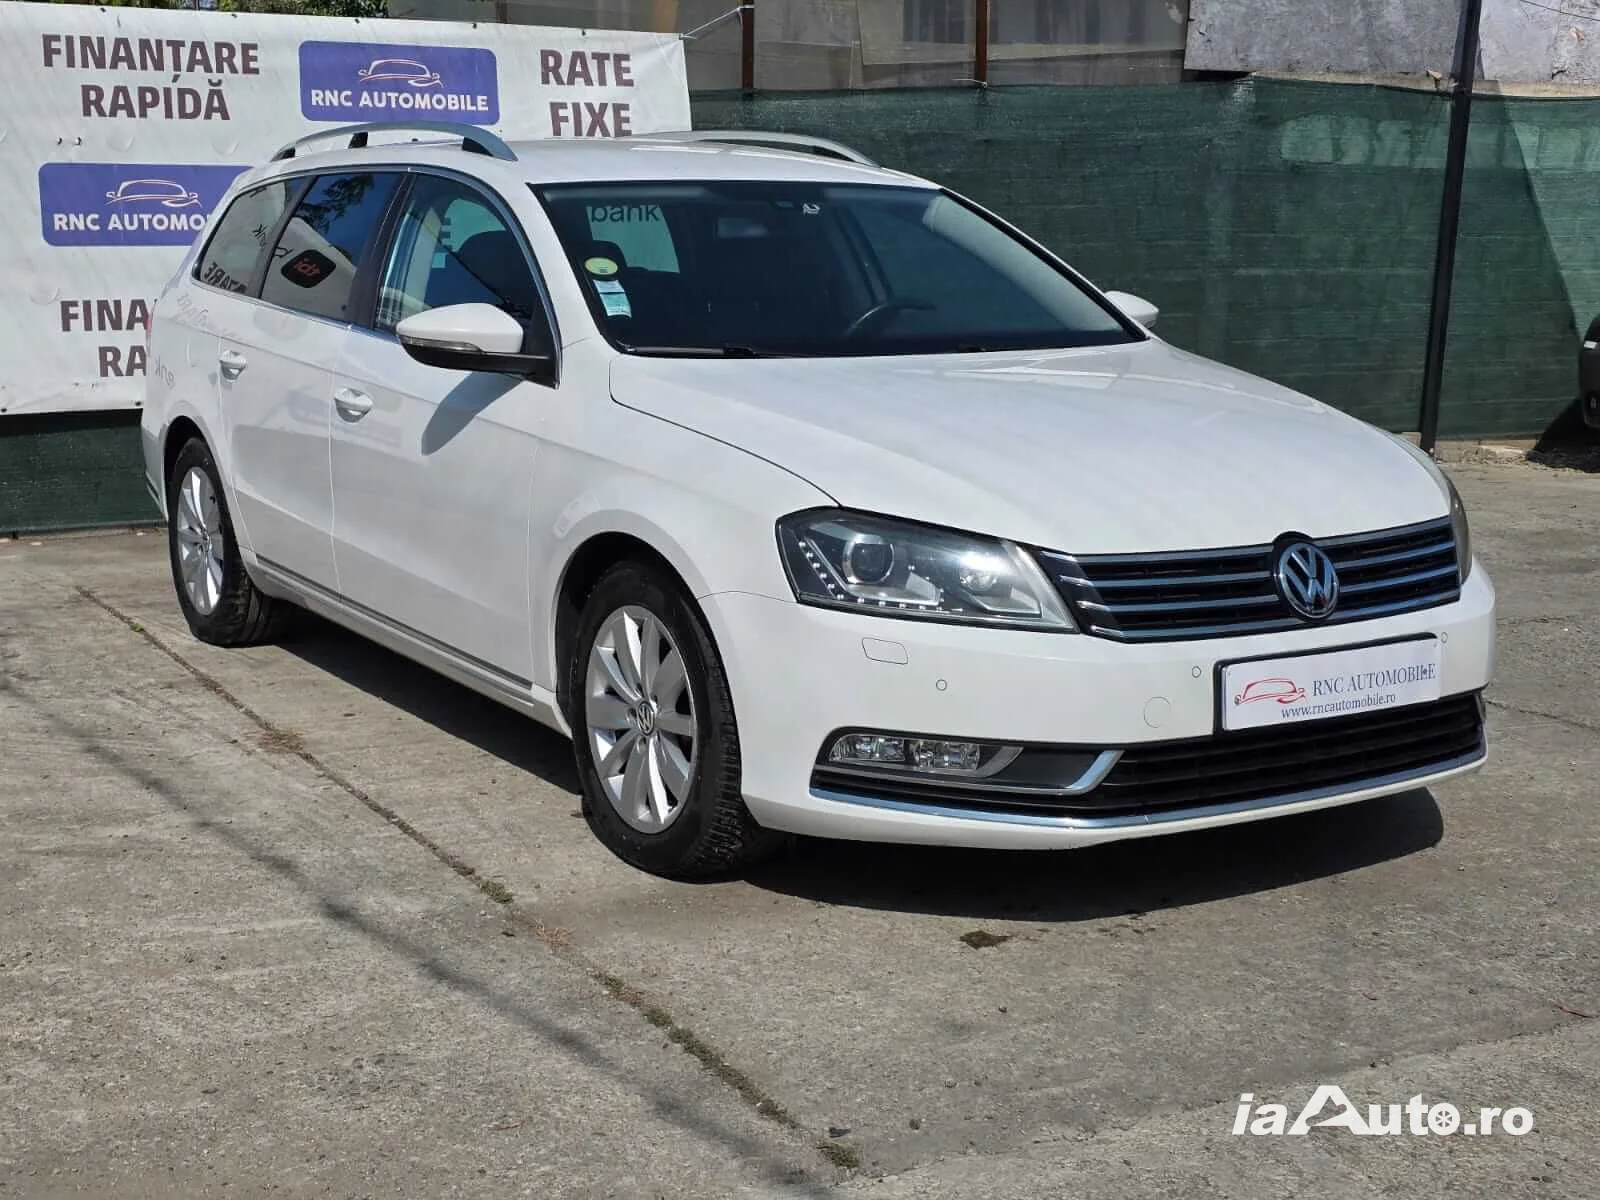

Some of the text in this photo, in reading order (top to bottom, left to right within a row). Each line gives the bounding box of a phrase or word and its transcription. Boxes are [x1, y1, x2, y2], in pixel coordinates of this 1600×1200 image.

[540, 49, 634, 87] RATE
[81, 78, 231, 121] RAPIDĂ
[311, 90, 489, 111] RNC AUTOMOBILE
[550, 101, 632, 137] FIXE
[53, 213, 209, 231] RNC AUTOMO
[1313, 663, 1436, 697] RNC AUTOMOBILE
[1281, 693, 1397, 719] www.rncautomobile.ro
